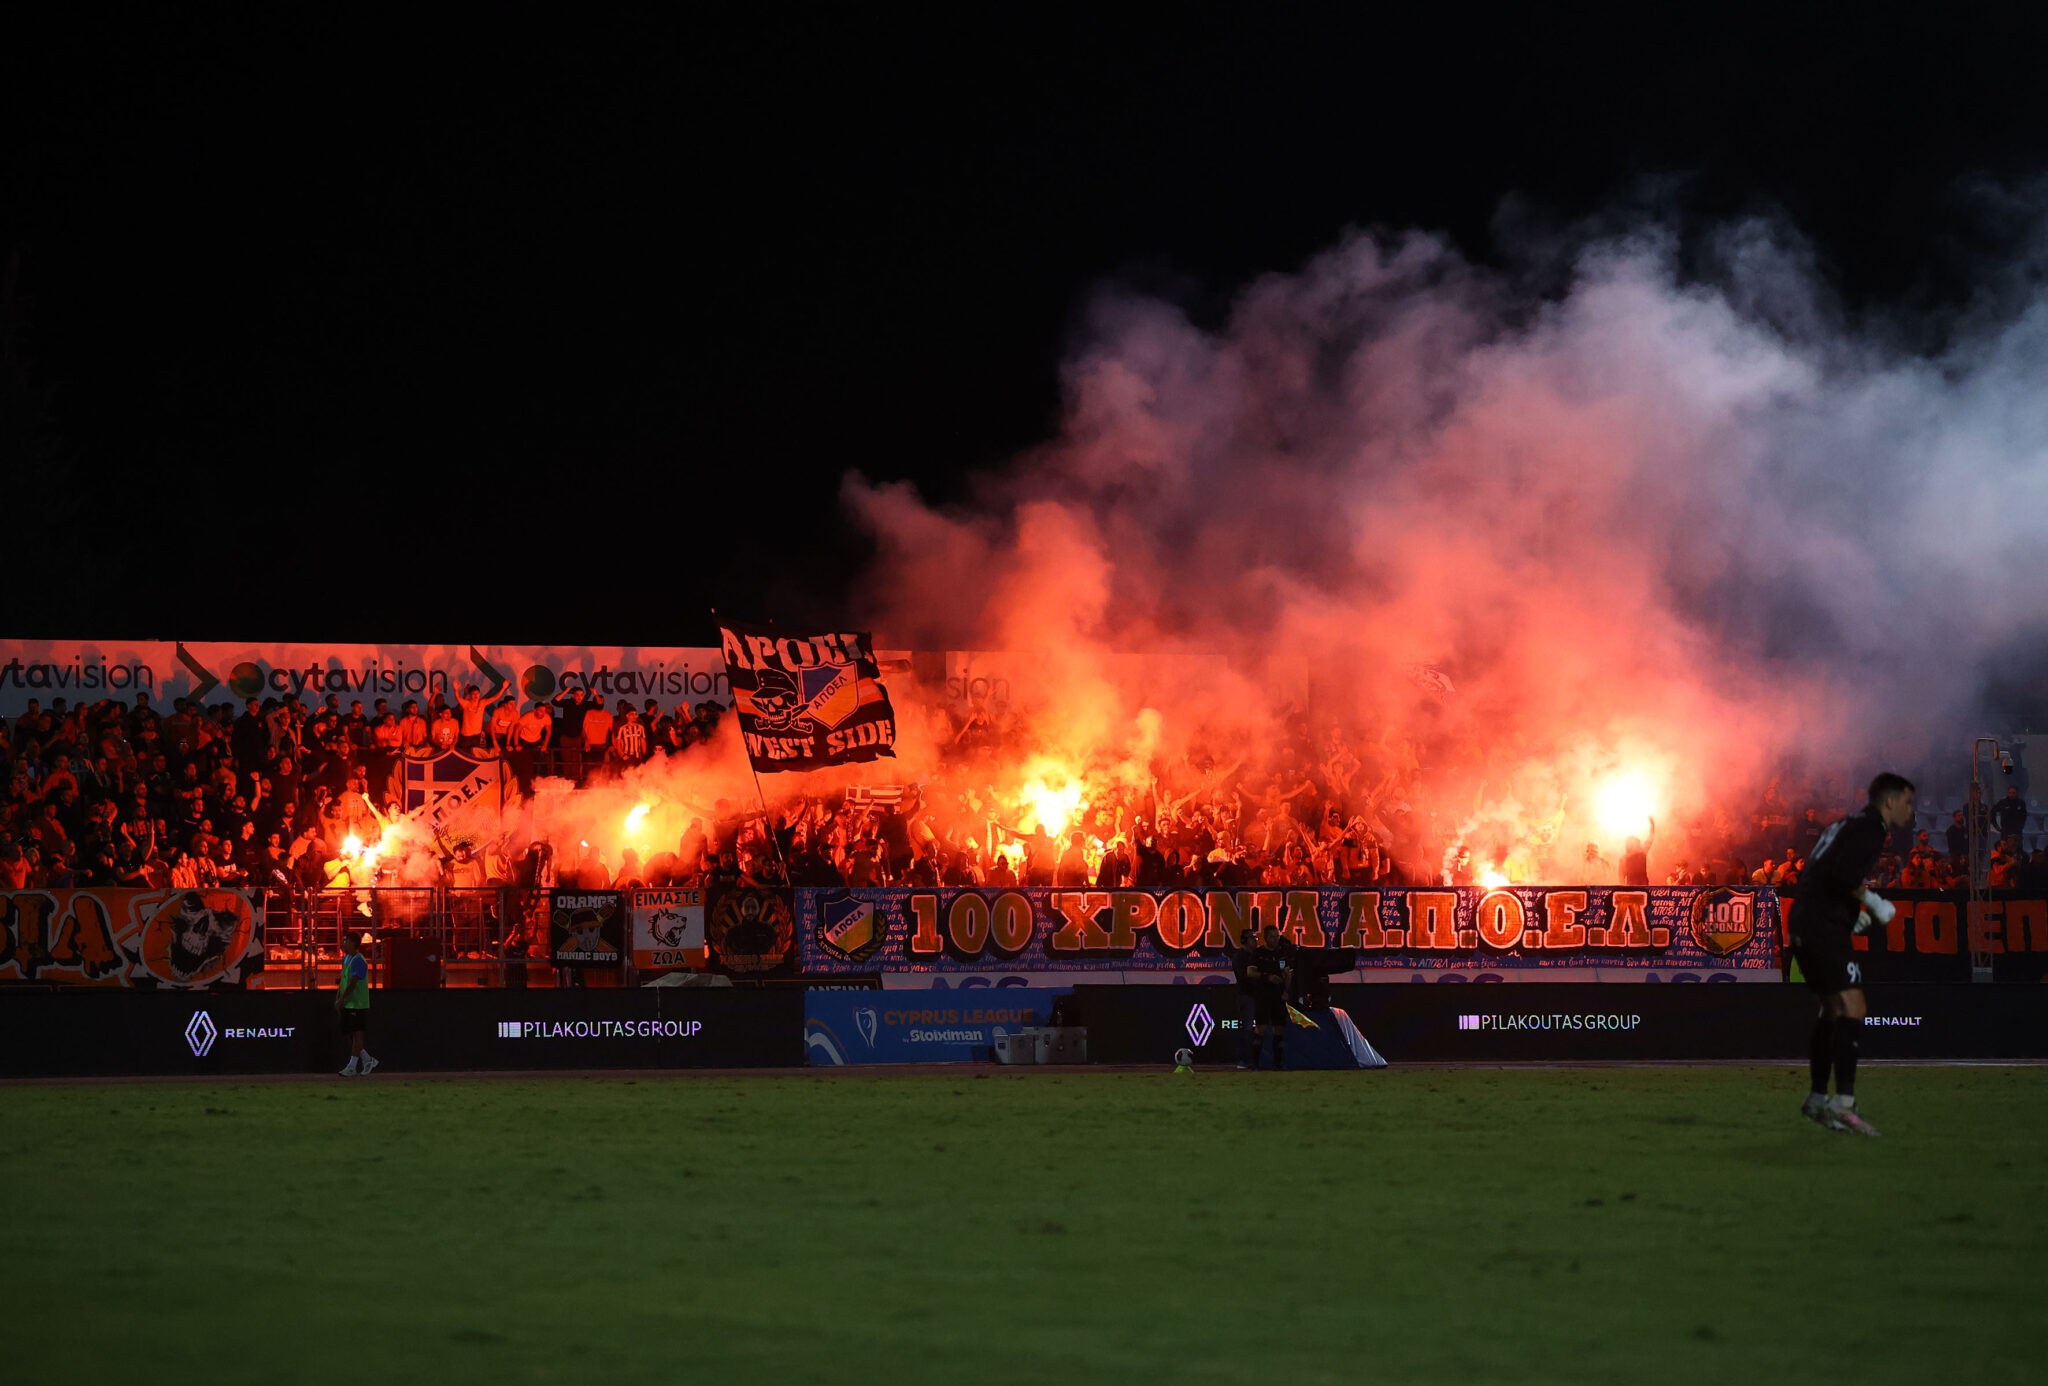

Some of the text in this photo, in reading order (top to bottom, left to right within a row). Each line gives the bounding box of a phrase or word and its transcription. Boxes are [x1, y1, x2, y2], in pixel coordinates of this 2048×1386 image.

[720, 626, 874, 673] APOEL
[269, 660, 448, 699] cytavision
[559, 662, 731, 703] cytavision
[814, 675, 848, 710] ΑΠΟΕΛ
[744, 719, 894, 760] WEST SIDE
[557, 895, 617, 909] ORANGE
[636, 890, 700, 907] ΕΙΜΑΣΤΕ
[910, 891, 1033, 951] 100
[1051, 891, 1325, 951] ΧΡΟΝΙΑ
[1341, 889, 1670, 949] Α.Π.Ο.Ε.Λ.
[1708, 902, 1747, 923] 100
[834, 910, 865, 938] ΑΠΟΕΛ
[1704, 922, 1748, 933] ΧΡΟΝΙΑ
[592, 951, 618, 961] BOYS
[653, 951, 686, 965] ΖΩΑ
[884, 1008, 1034, 1025] CYPRUS LEAGUE
[1864, 1016, 1922, 1026] RENAULT
[225, 1027, 295, 1039] RENAULT
[909, 1029, 983, 1042] Stoiximan
